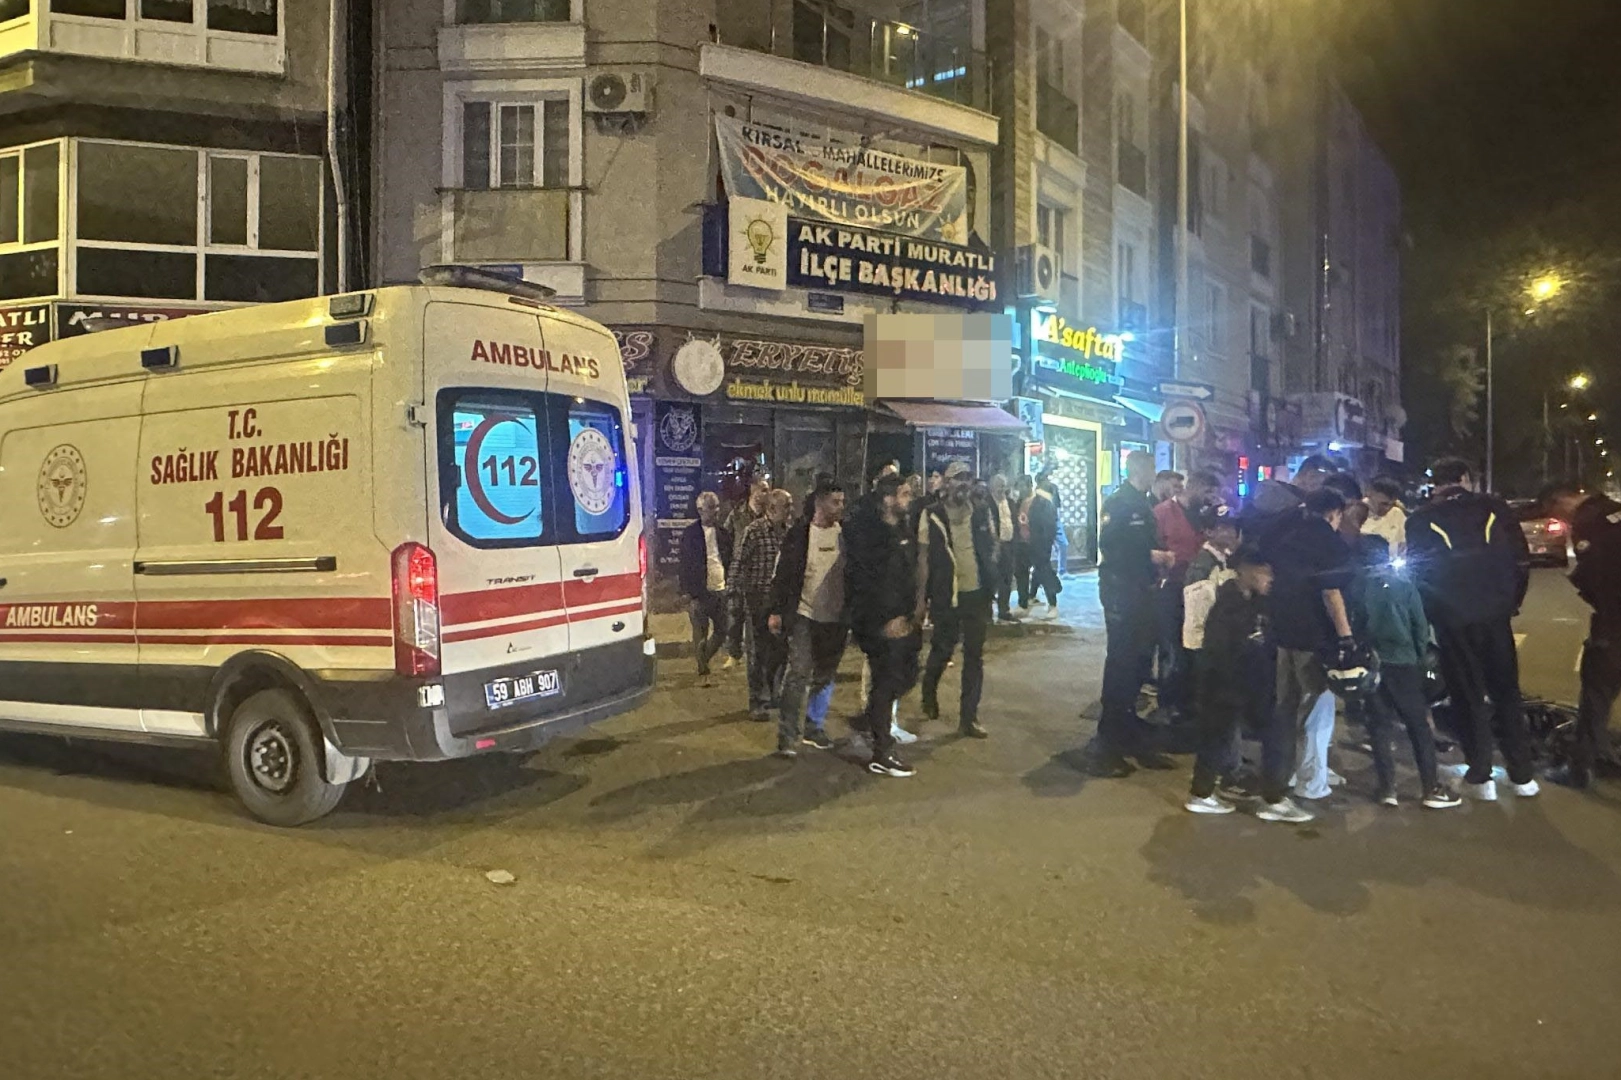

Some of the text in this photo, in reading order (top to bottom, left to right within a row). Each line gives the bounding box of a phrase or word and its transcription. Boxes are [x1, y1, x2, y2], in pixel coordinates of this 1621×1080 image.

[742, 126, 805, 155] KIRSAL
[854, 204, 920, 229] OLSUN
[798, 225, 995, 272] AK PARTİ MURATLI
[742, 265, 753, 273] AK
[800, 247, 852, 285] İLÇE
[858, 260, 997, 301] BAŞKANLIĞI
[470, 339, 600, 379] AMBULANS
[727, 377, 774, 400] ekmek
[227, 408, 262, 440] T.C.
[151, 432, 349, 485] SAĞLIK BAKANLIĞI
[482, 454, 538, 486] 112
[205, 486, 285, 542] 112
[5, 604, 98, 627] AMBULANS
[492, 672, 556, 702] 59 ABH 907
